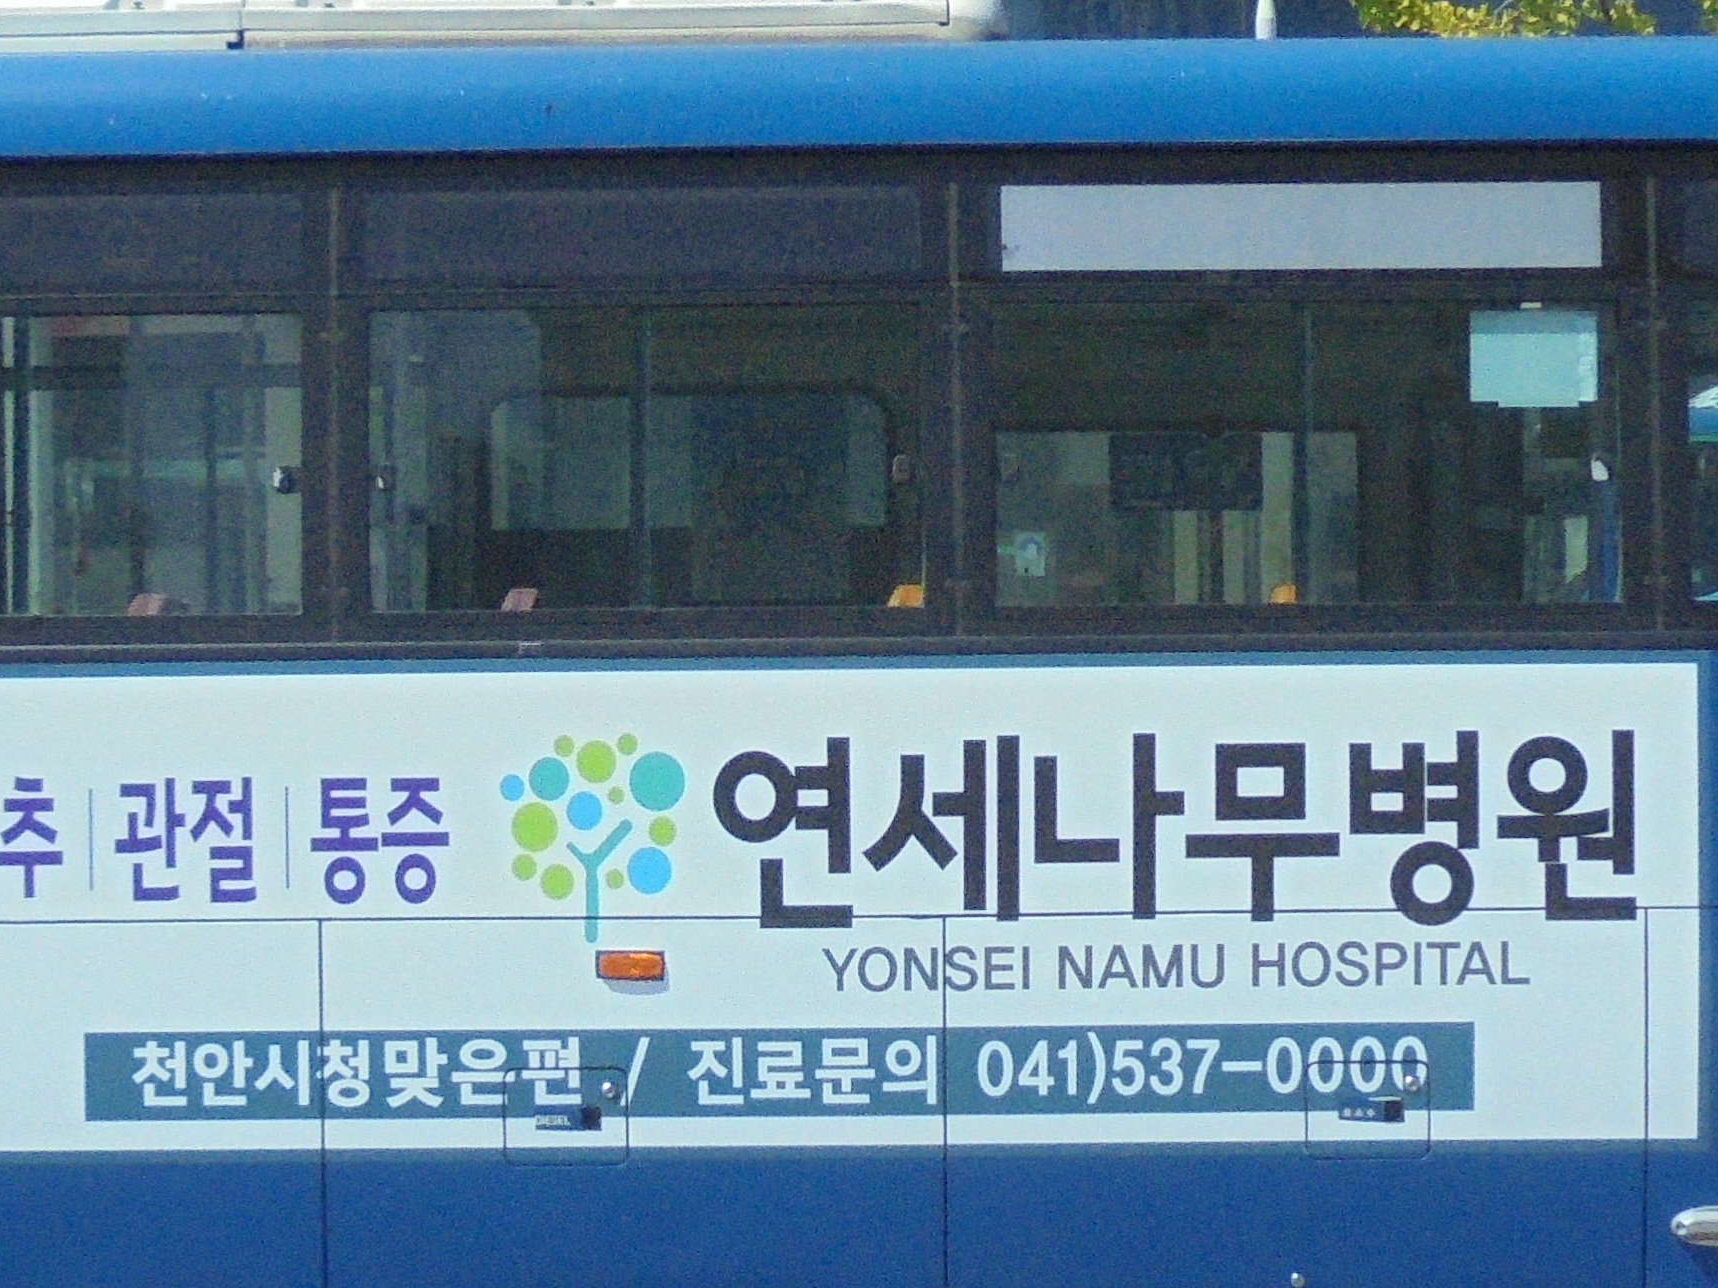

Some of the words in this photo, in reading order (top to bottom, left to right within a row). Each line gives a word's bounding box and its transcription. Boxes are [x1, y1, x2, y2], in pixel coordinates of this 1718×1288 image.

[113, 776, 259, 904] 관절
[309, 776, 451, 906] 통증
[711, 728, 1639, 930] 연세나무병원
[821, 946, 1031, 994] YONSEI
[1057, 942, 1227, 991] NAMU
[1251, 940, 1531, 988] HOSPITAL
[131, 1038, 585, 1110] 천안시청맞은편
[686, 1036, 941, 1108] 진료문의
[975, 1034, 1429, 1107] 041)537-0000
